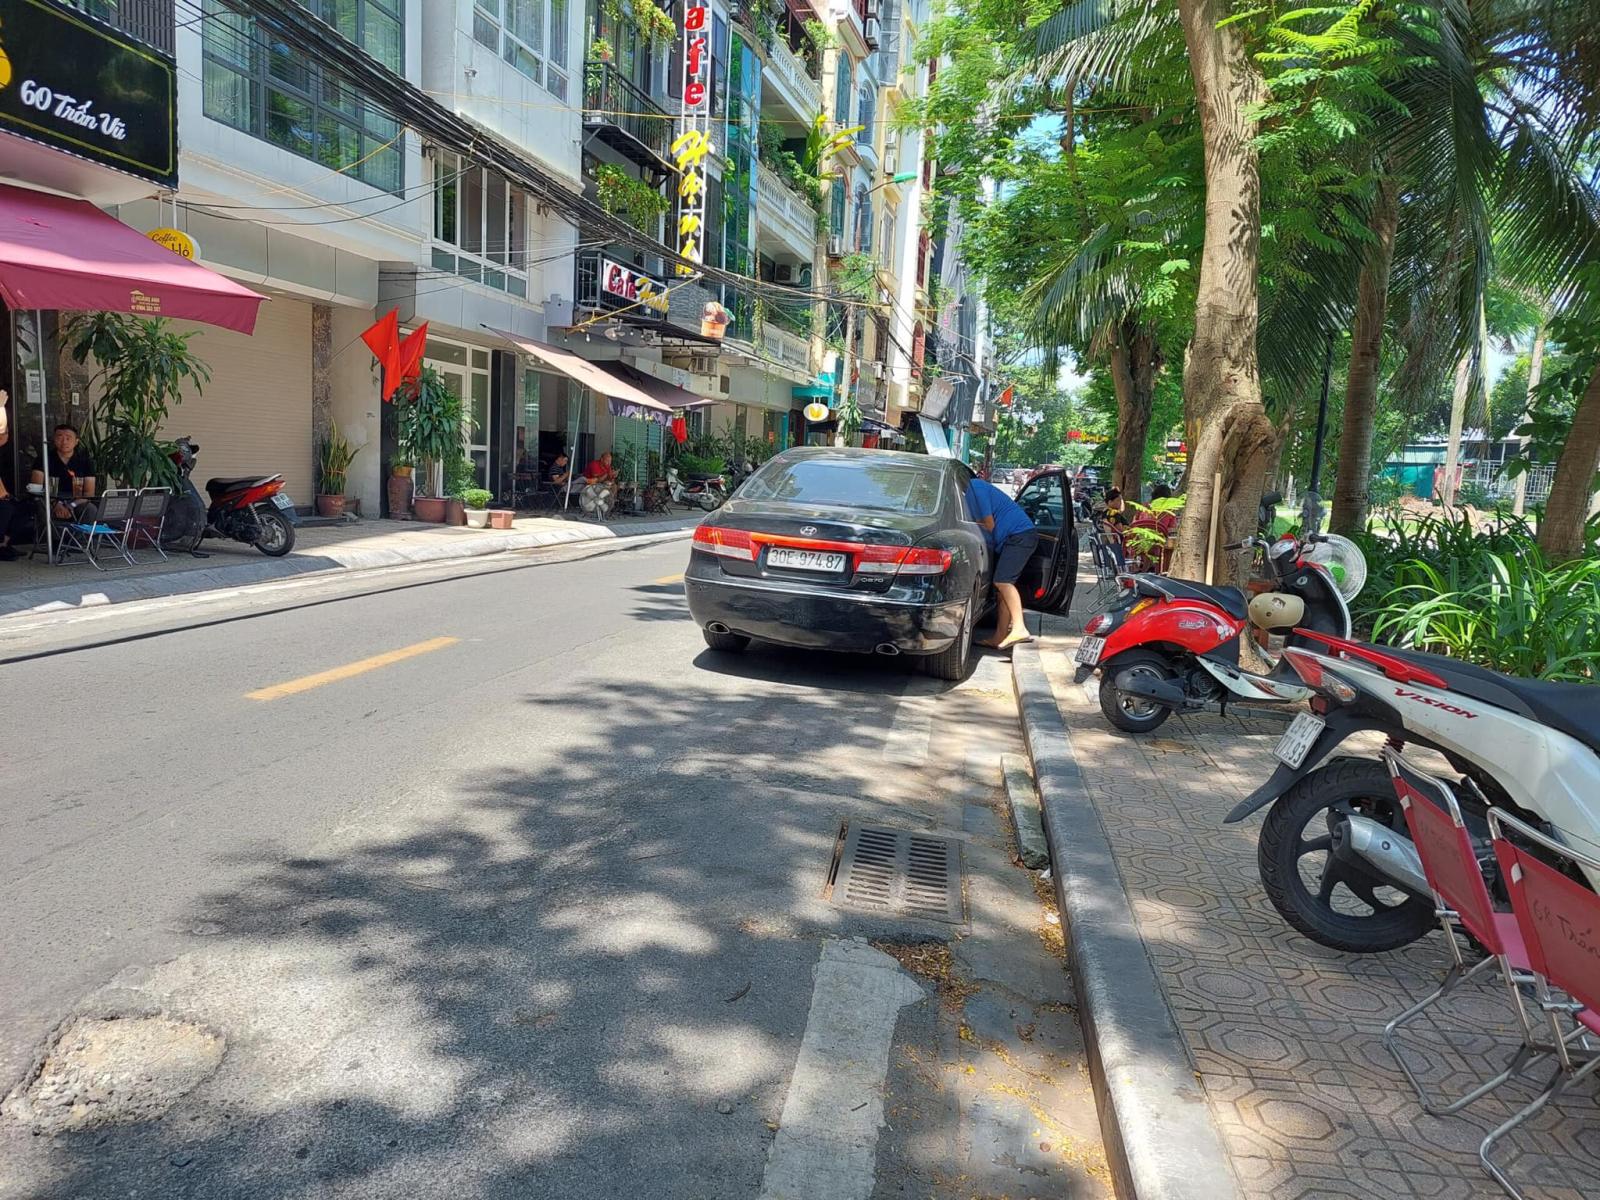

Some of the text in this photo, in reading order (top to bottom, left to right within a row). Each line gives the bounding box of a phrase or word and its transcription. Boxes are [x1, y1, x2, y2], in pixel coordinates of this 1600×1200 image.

[21, 79, 126, 140] 60 Trấn Vũ
[151, 232, 178, 245] Coffee
[1394, 686, 1479, 719] VISION
